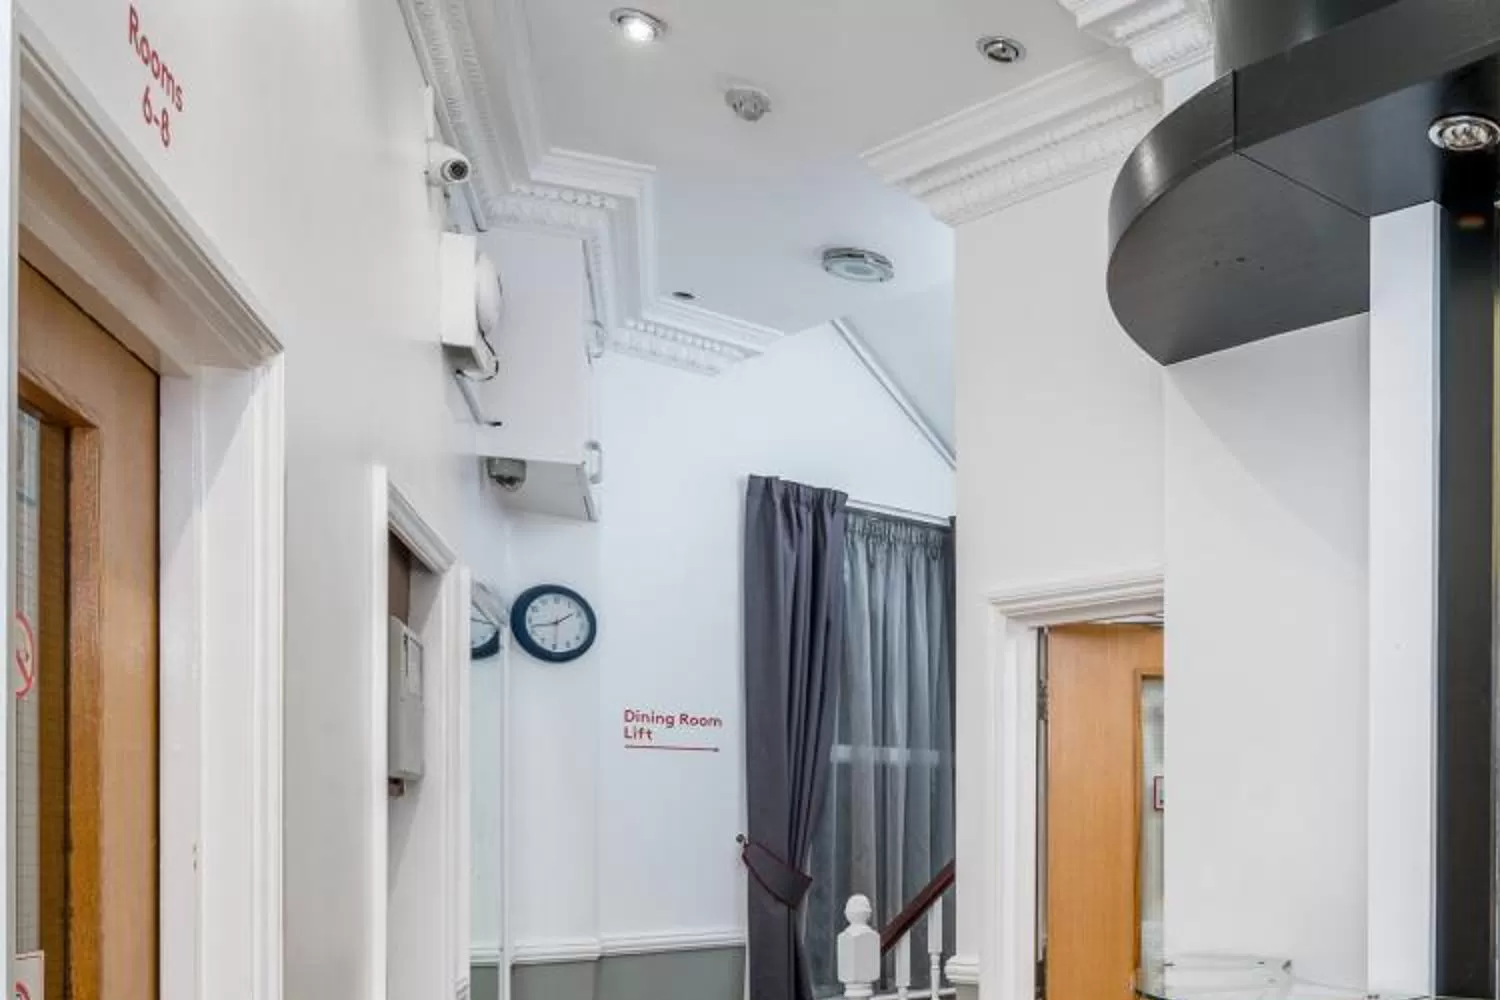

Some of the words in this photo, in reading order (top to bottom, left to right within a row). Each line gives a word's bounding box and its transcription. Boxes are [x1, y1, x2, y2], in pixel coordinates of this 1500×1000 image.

[127, 3, 184, 112] Rooms
[142, 85, 170, 148] 6-8
[623, 708, 675, 728] Dining
[679, 713, 723, 727] Room
[623, 725, 653, 740] Lift
